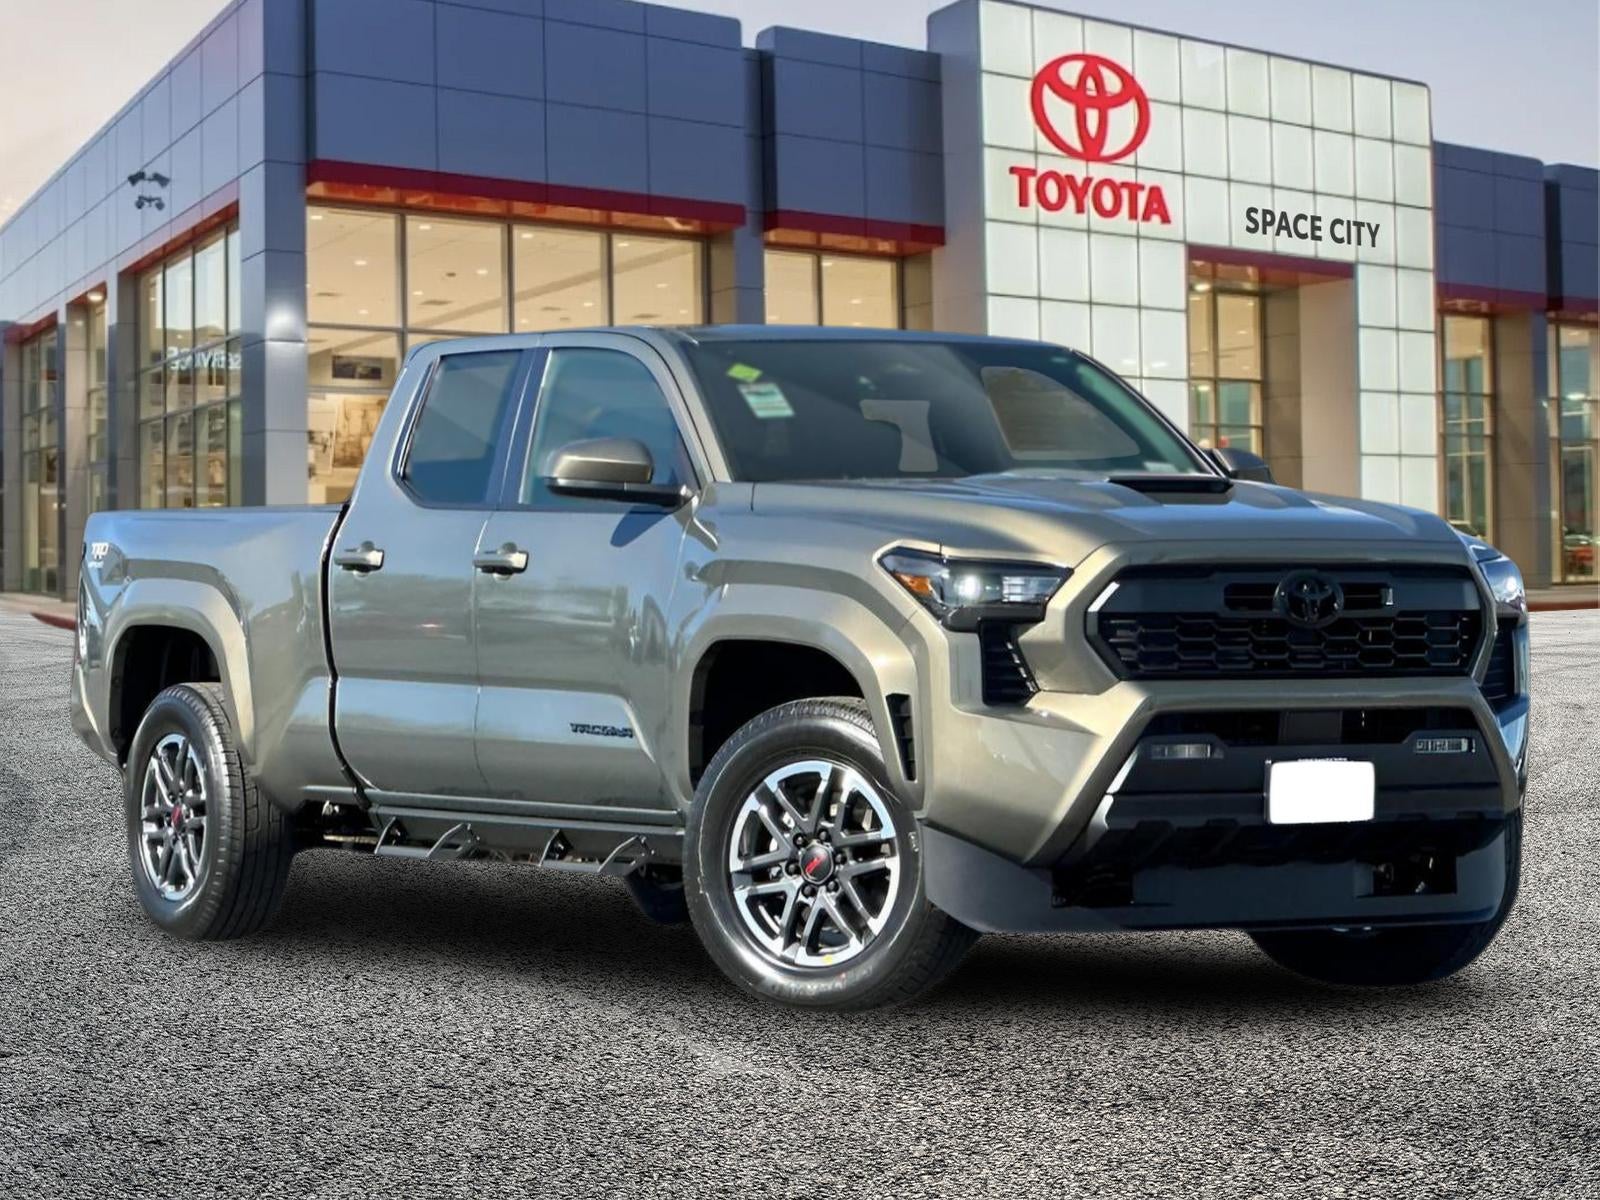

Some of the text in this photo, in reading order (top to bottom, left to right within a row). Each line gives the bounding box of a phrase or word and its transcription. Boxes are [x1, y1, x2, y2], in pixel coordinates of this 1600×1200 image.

[1009, 166, 1171, 224] TOYOTA
[1245, 207, 1380, 248] SPACE CITY
